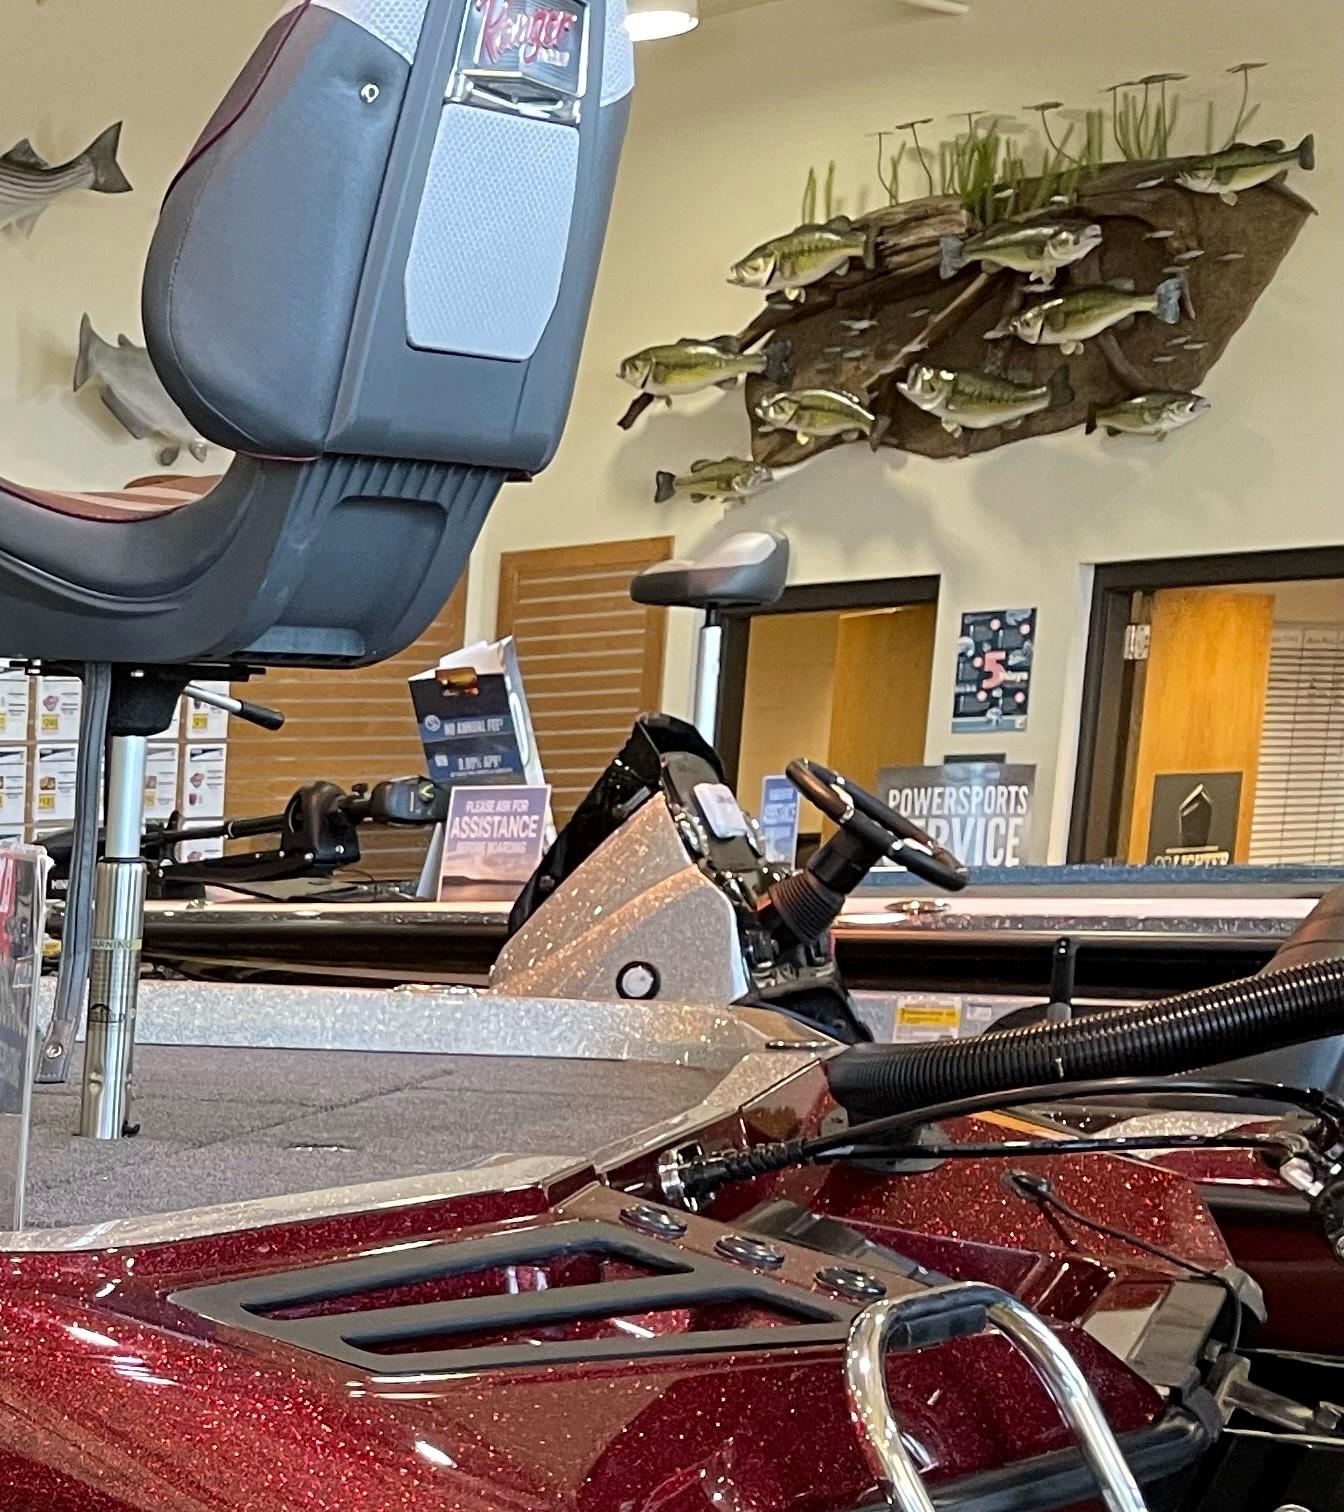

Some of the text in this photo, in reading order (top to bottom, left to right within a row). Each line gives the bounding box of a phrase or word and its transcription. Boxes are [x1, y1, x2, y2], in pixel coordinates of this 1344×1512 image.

[466, 799, 529, 813] PLEASE ASK FOR
[888, 785, 1029, 817] POWERSPORTS
[450, 815, 539, 839] ASSISTANCE
[909, 817, 1024, 867] RVICE
